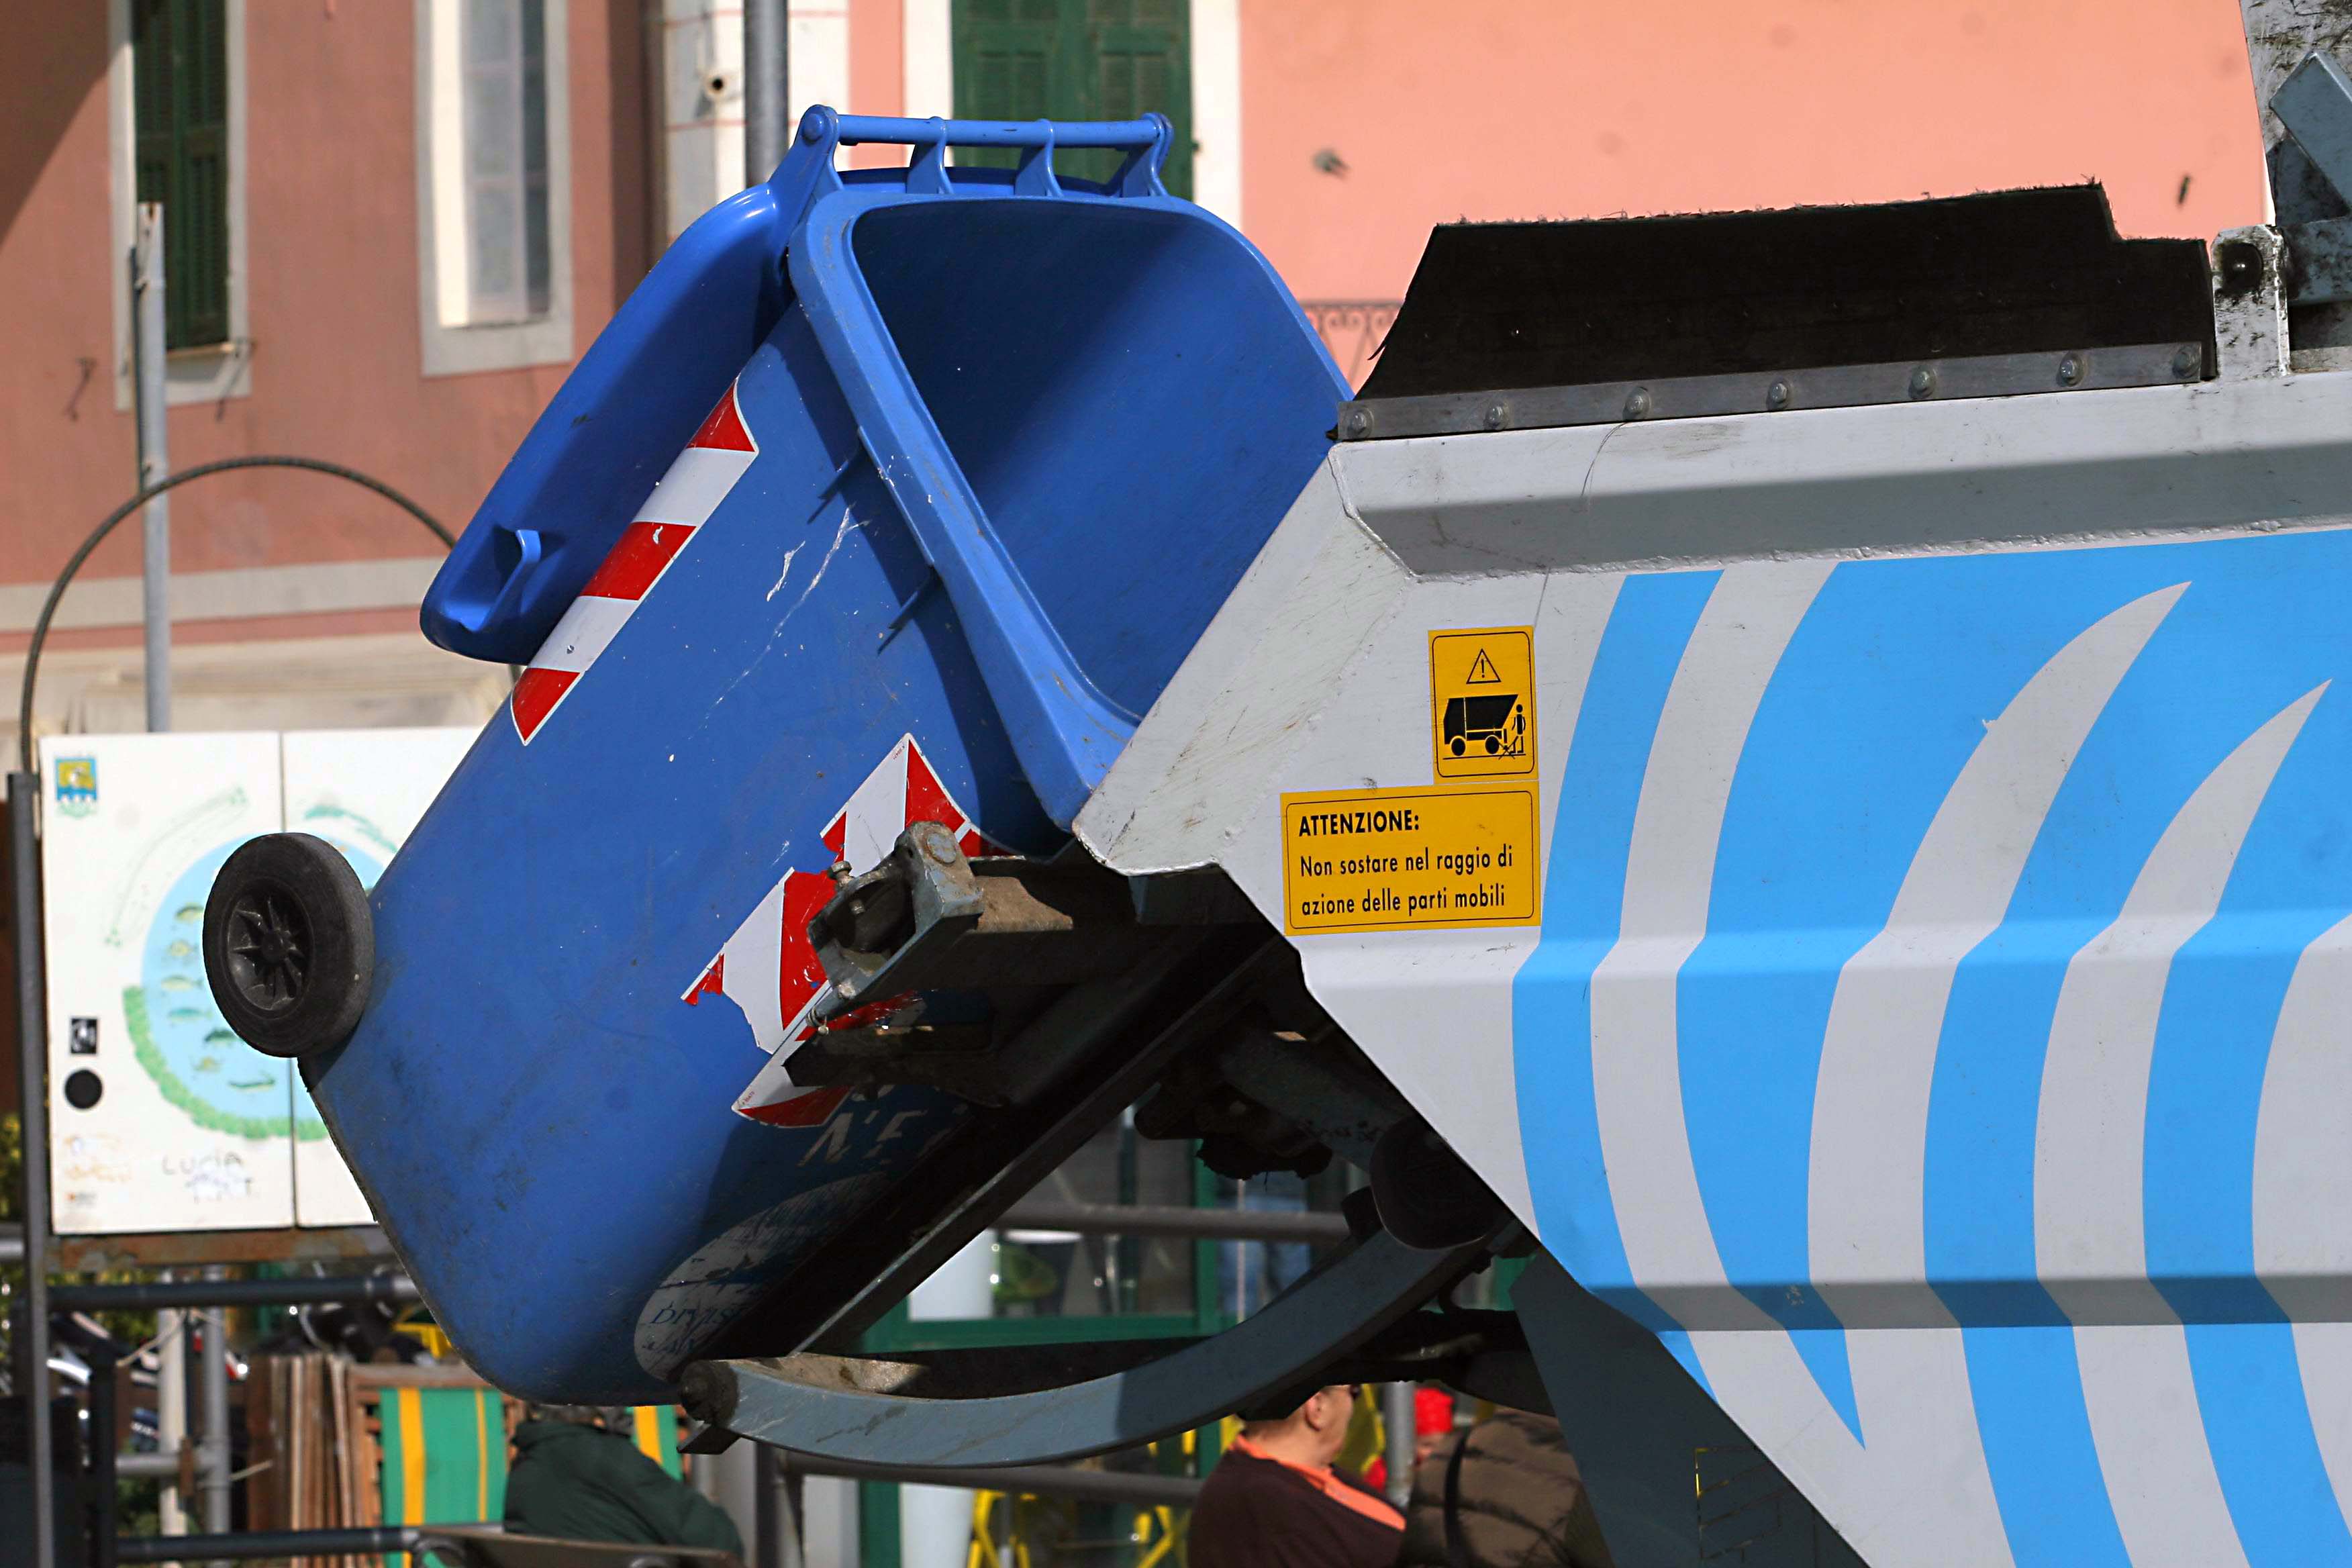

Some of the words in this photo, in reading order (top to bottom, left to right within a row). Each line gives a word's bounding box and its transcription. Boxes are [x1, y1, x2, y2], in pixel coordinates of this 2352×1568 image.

[1299, 810, 1419, 837] ATTENZIONE:
[1300, 855, 1332, 877] Non
[1340, 854, 1398, 875] sostare
[1406, 846, 1429, 871] nel
[1436, 846, 1491, 876] raggio
[1498, 843, 1512, 867] di
[1302, 893, 1355, 916] azione
[1362, 887, 1401, 912] delle
[1408, 887, 1447, 917] parti
[1455, 883, 1504, 908] mobili
